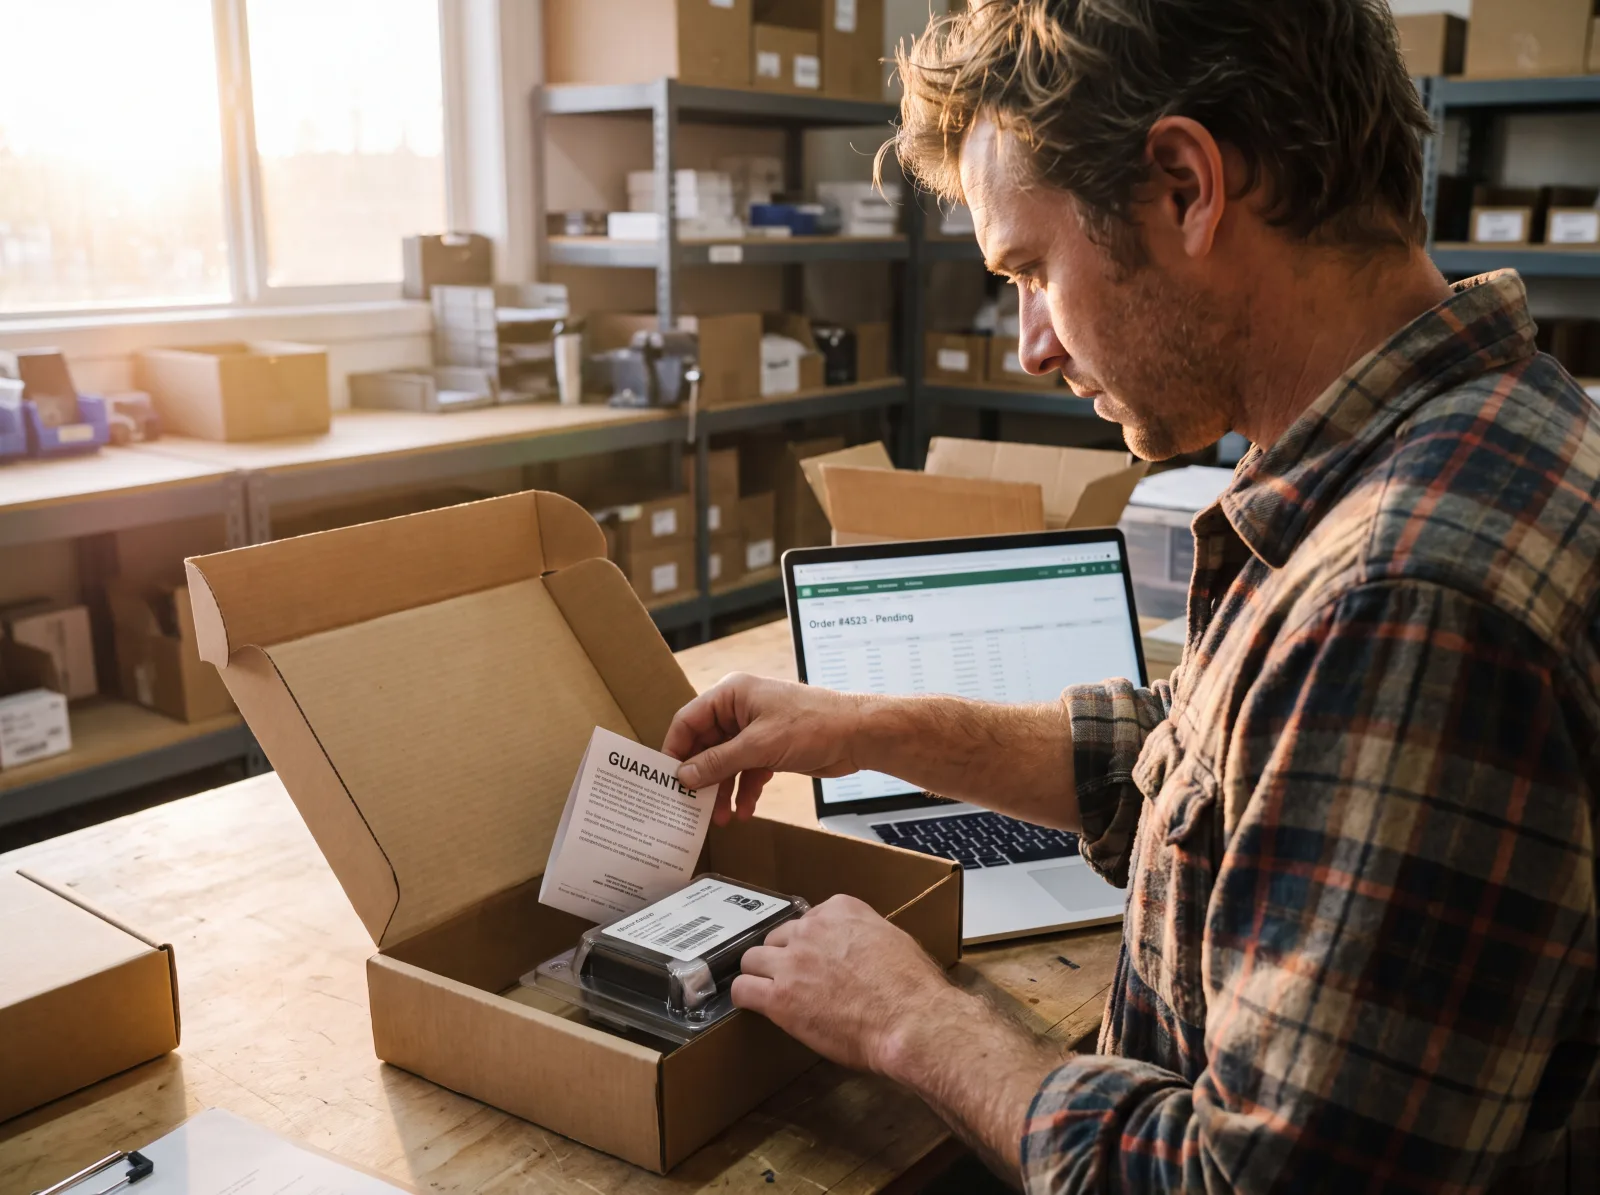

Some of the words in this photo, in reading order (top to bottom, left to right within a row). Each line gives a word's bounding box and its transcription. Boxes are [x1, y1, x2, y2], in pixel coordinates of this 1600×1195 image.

[809, 620, 835, 629] Order
[838, 616, 868, 626] #4523
[875, 613, 914, 623] Pending
[608, 751, 698, 799] GUARANTEE
